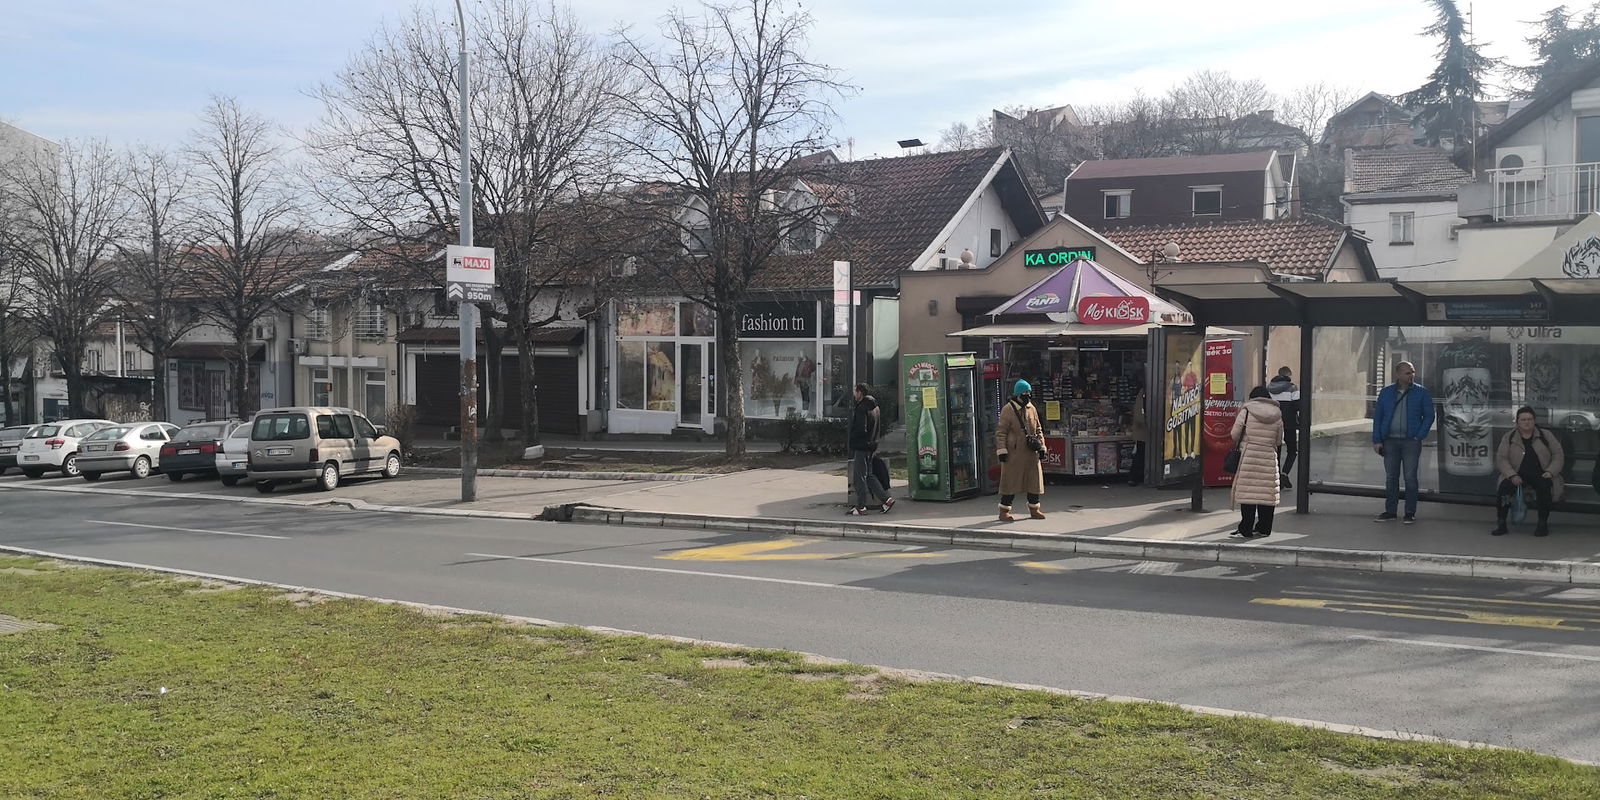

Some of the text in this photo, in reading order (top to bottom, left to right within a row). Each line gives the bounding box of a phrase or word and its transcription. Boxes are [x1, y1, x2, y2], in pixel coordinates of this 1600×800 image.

[464, 257, 489, 269] MAXI
[1025, 253, 1046, 266] KA
[467, 291, 492, 301] 950m
[1026, 296, 1060, 307] FANTA
[1083, 303, 1105, 320] Moj
[741, 313, 805, 332] fashion tn
[1527, 326, 1562, 338] ultra
[1450, 442, 1488, 457] ultra
